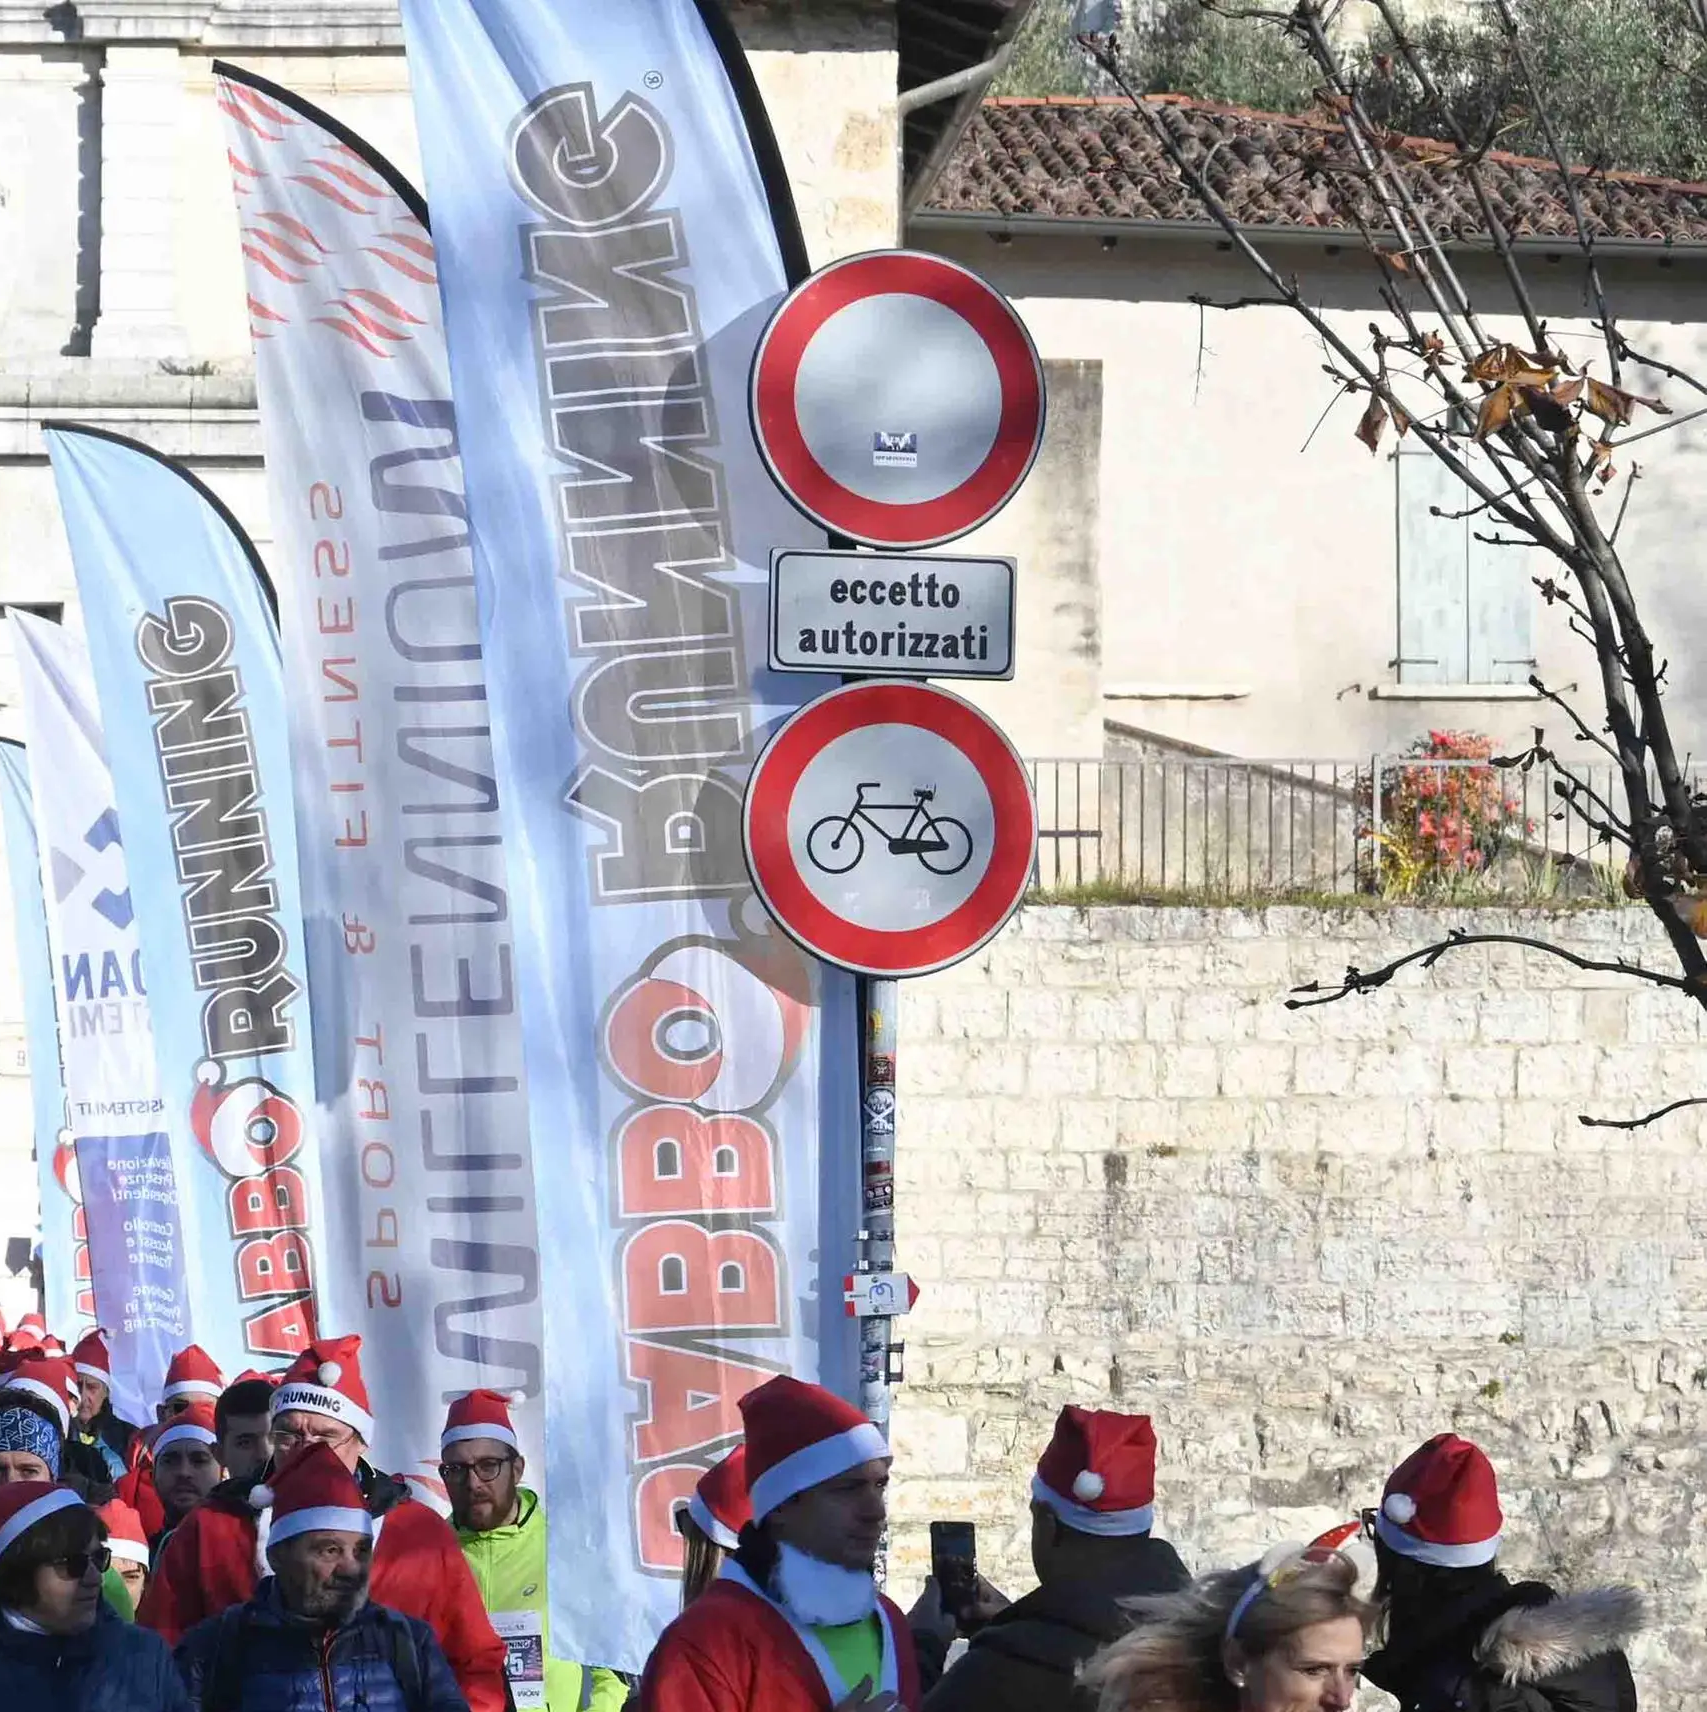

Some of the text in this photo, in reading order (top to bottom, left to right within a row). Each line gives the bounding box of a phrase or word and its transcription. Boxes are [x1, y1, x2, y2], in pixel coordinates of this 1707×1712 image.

[830, 572, 961, 609] eccetto
[798, 620, 989, 660] autorizzati
[134, 594, 321, 1362] ABBO RUNNING
[282, 1391, 341, 1413] RUNNING
